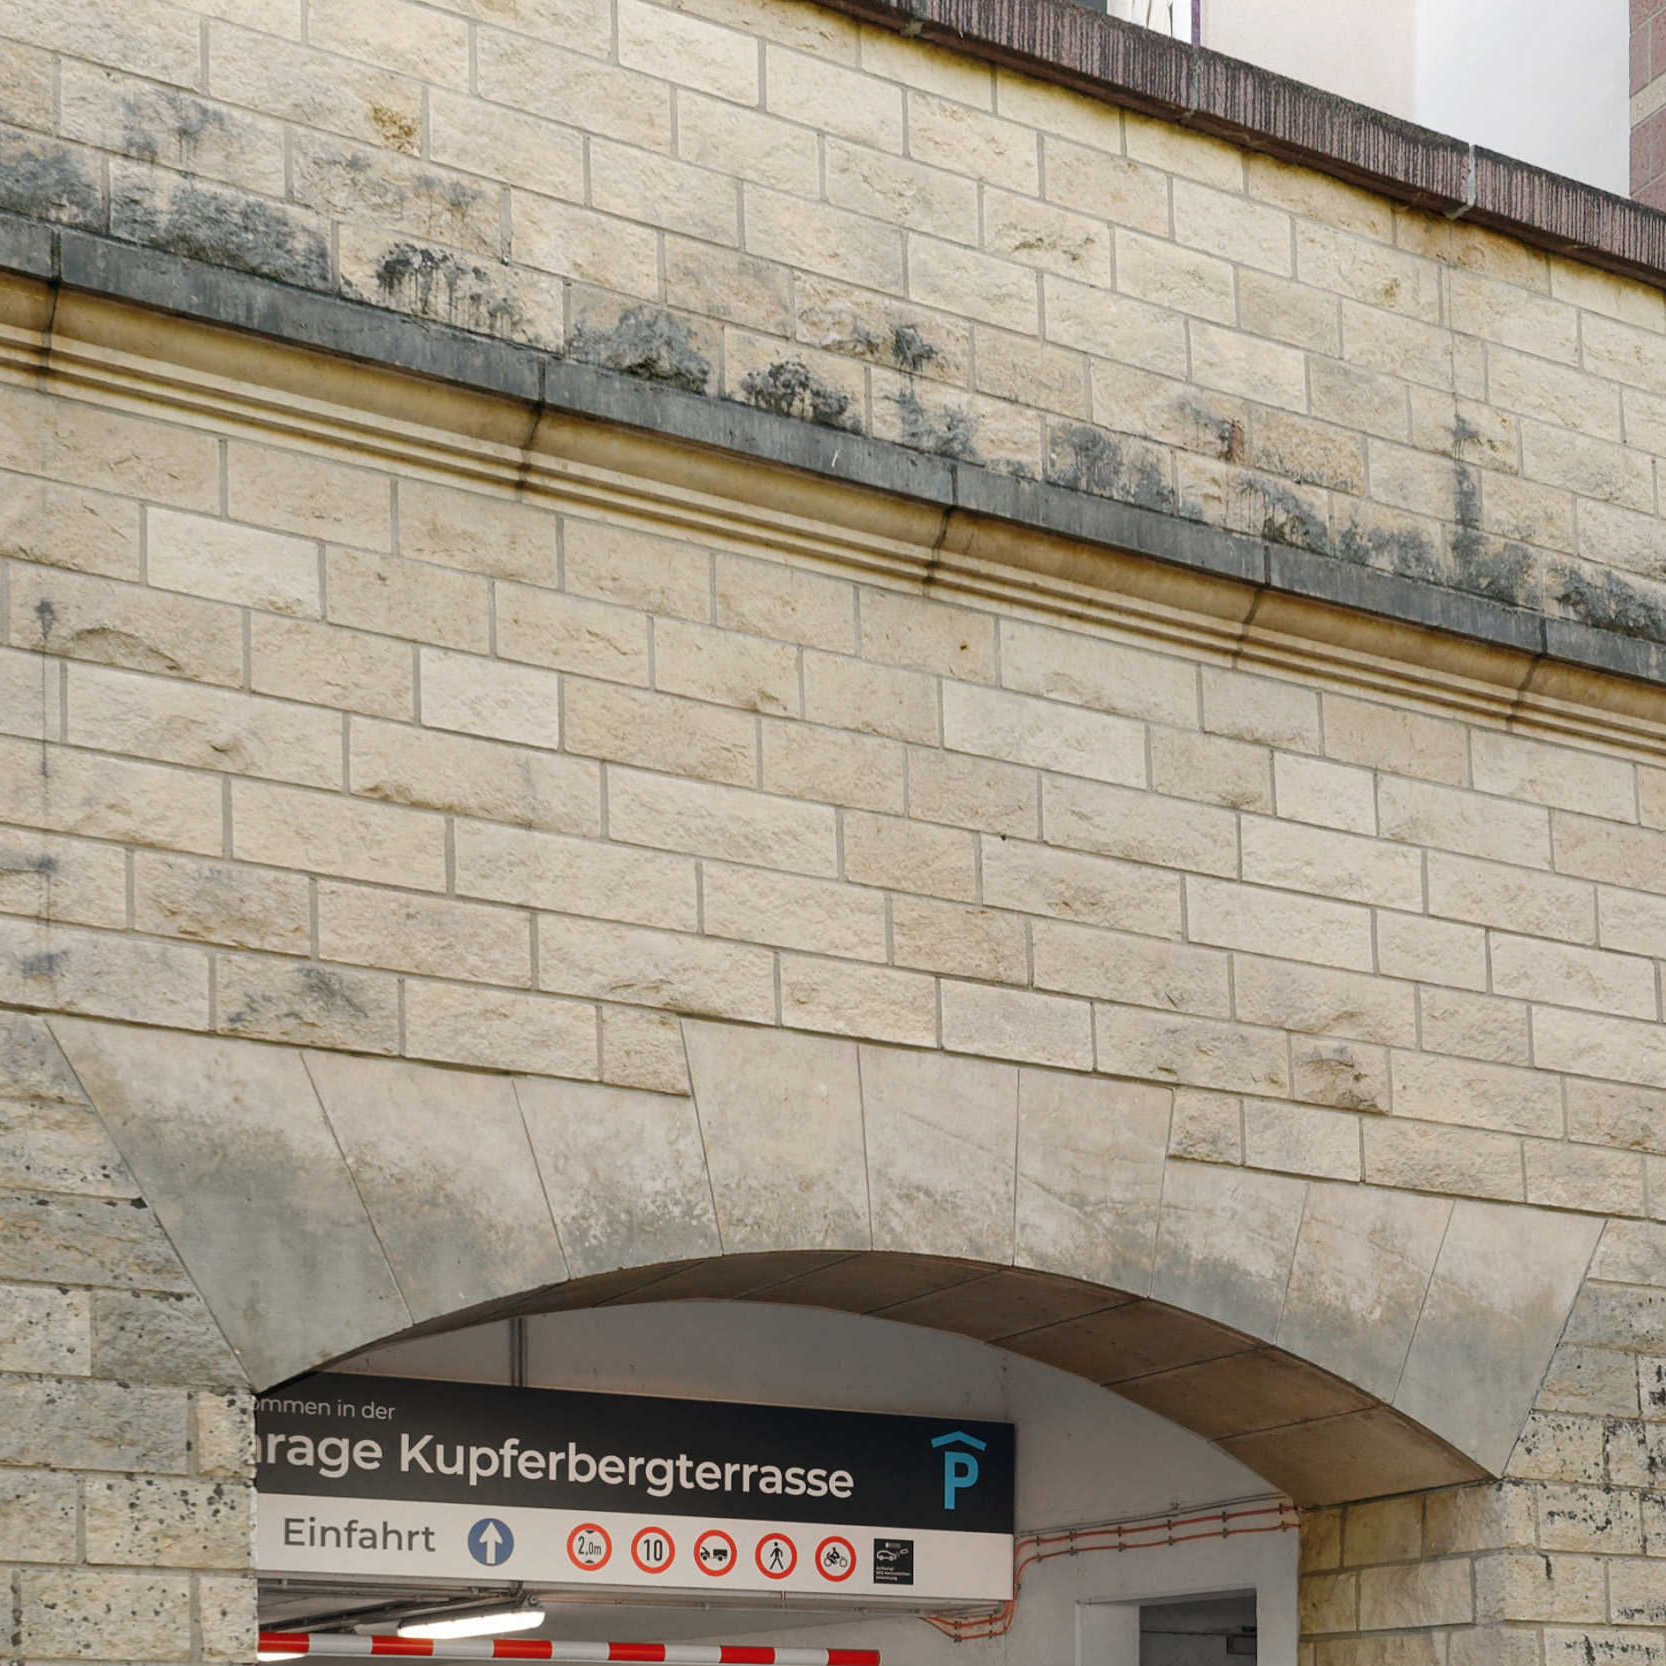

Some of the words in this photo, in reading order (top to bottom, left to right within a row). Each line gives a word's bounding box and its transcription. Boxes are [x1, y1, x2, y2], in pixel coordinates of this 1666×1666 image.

[337, 1399, 356, 1418] in
[361, 1401, 396, 1420] der
[255, 1432, 383, 1478] rage
[400, 1432, 855, 1498] Kupferbergterrasse
[944, 1451, 979, 1510] P
[284, 1516, 436, 1552] Einfahrt
[578, 1536, 602, 1556] 2,0m
[643, 1539, 663, 1562] 10
